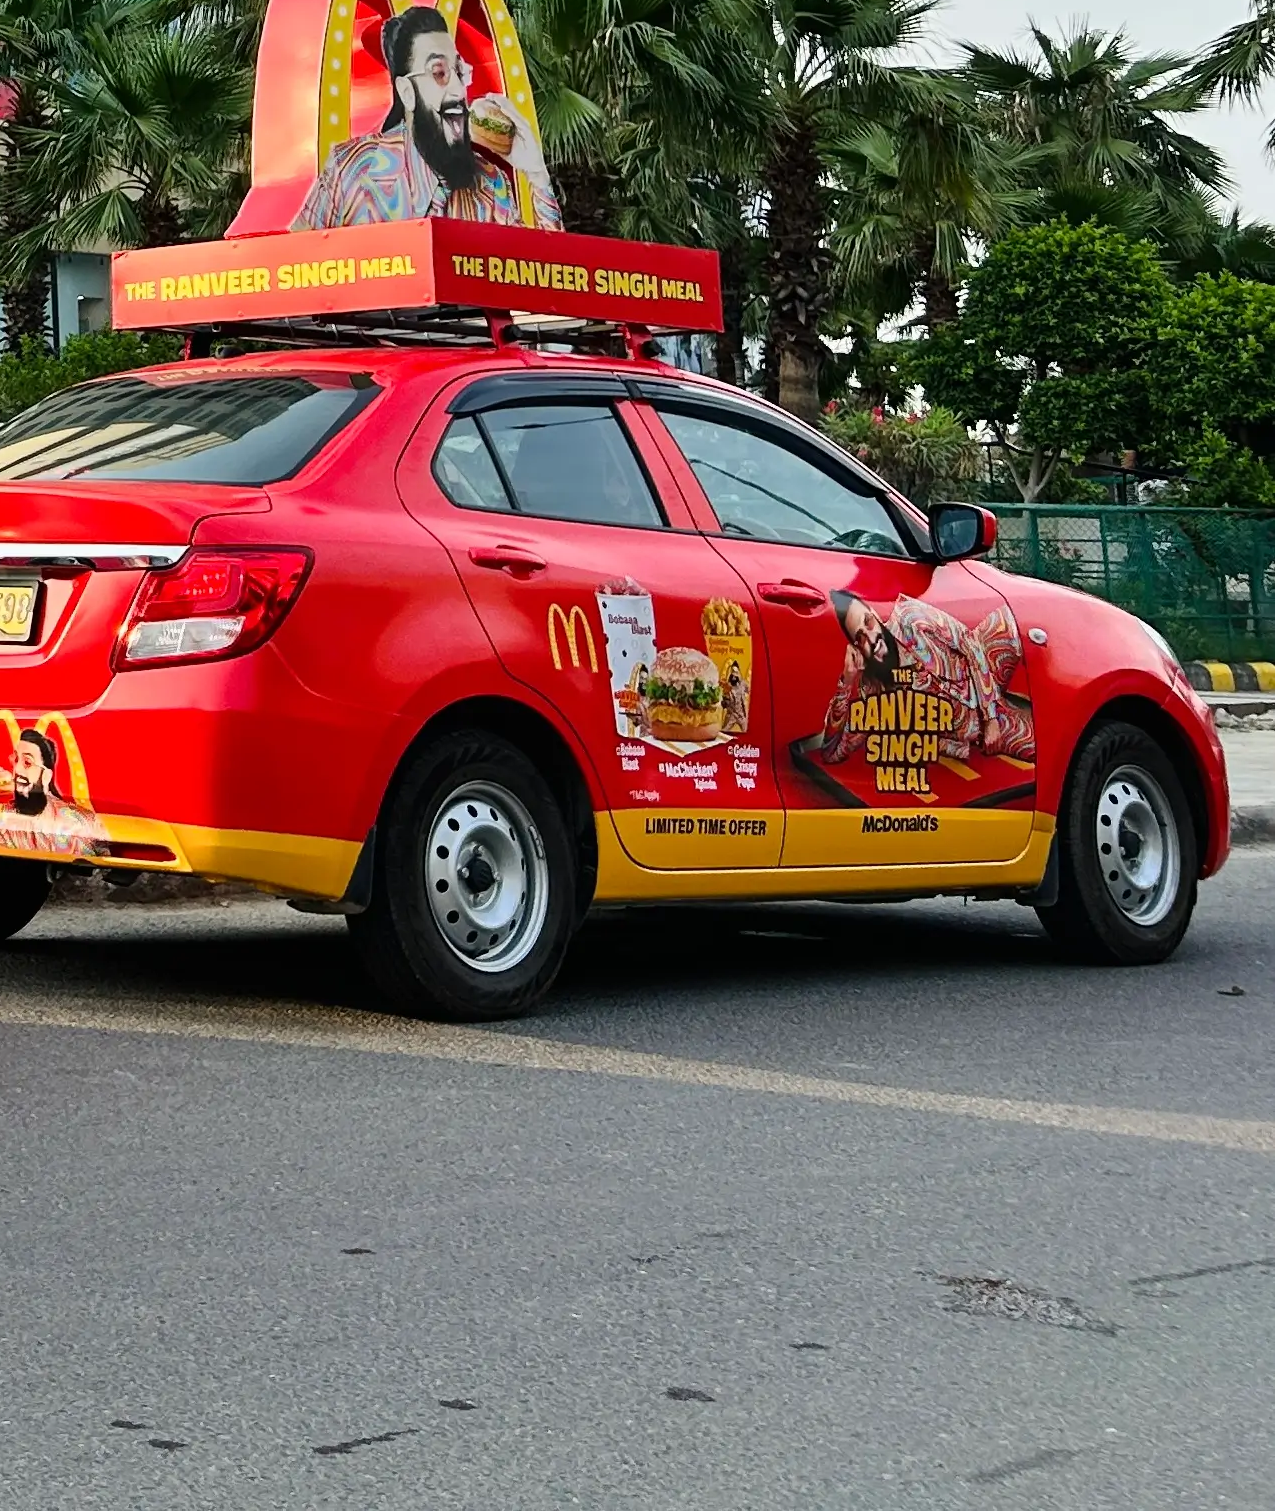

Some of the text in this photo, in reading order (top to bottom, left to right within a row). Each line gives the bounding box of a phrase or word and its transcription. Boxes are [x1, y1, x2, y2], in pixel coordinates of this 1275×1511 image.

[124, 255, 417, 303] THE RANVEER SINGH MEAL
[451, 254, 705, 303] THE RANVEER SINGH MEAL
[891, 669, 913, 683] THE
[849, 690, 954, 732] RANVEER
[865, 732, 939, 763] SINGH
[876, 766, 931, 792] MEAL
[645, 817, 767, 836] LIMITED TIME OFFER
[861, 814, 939, 833] McDonald's
